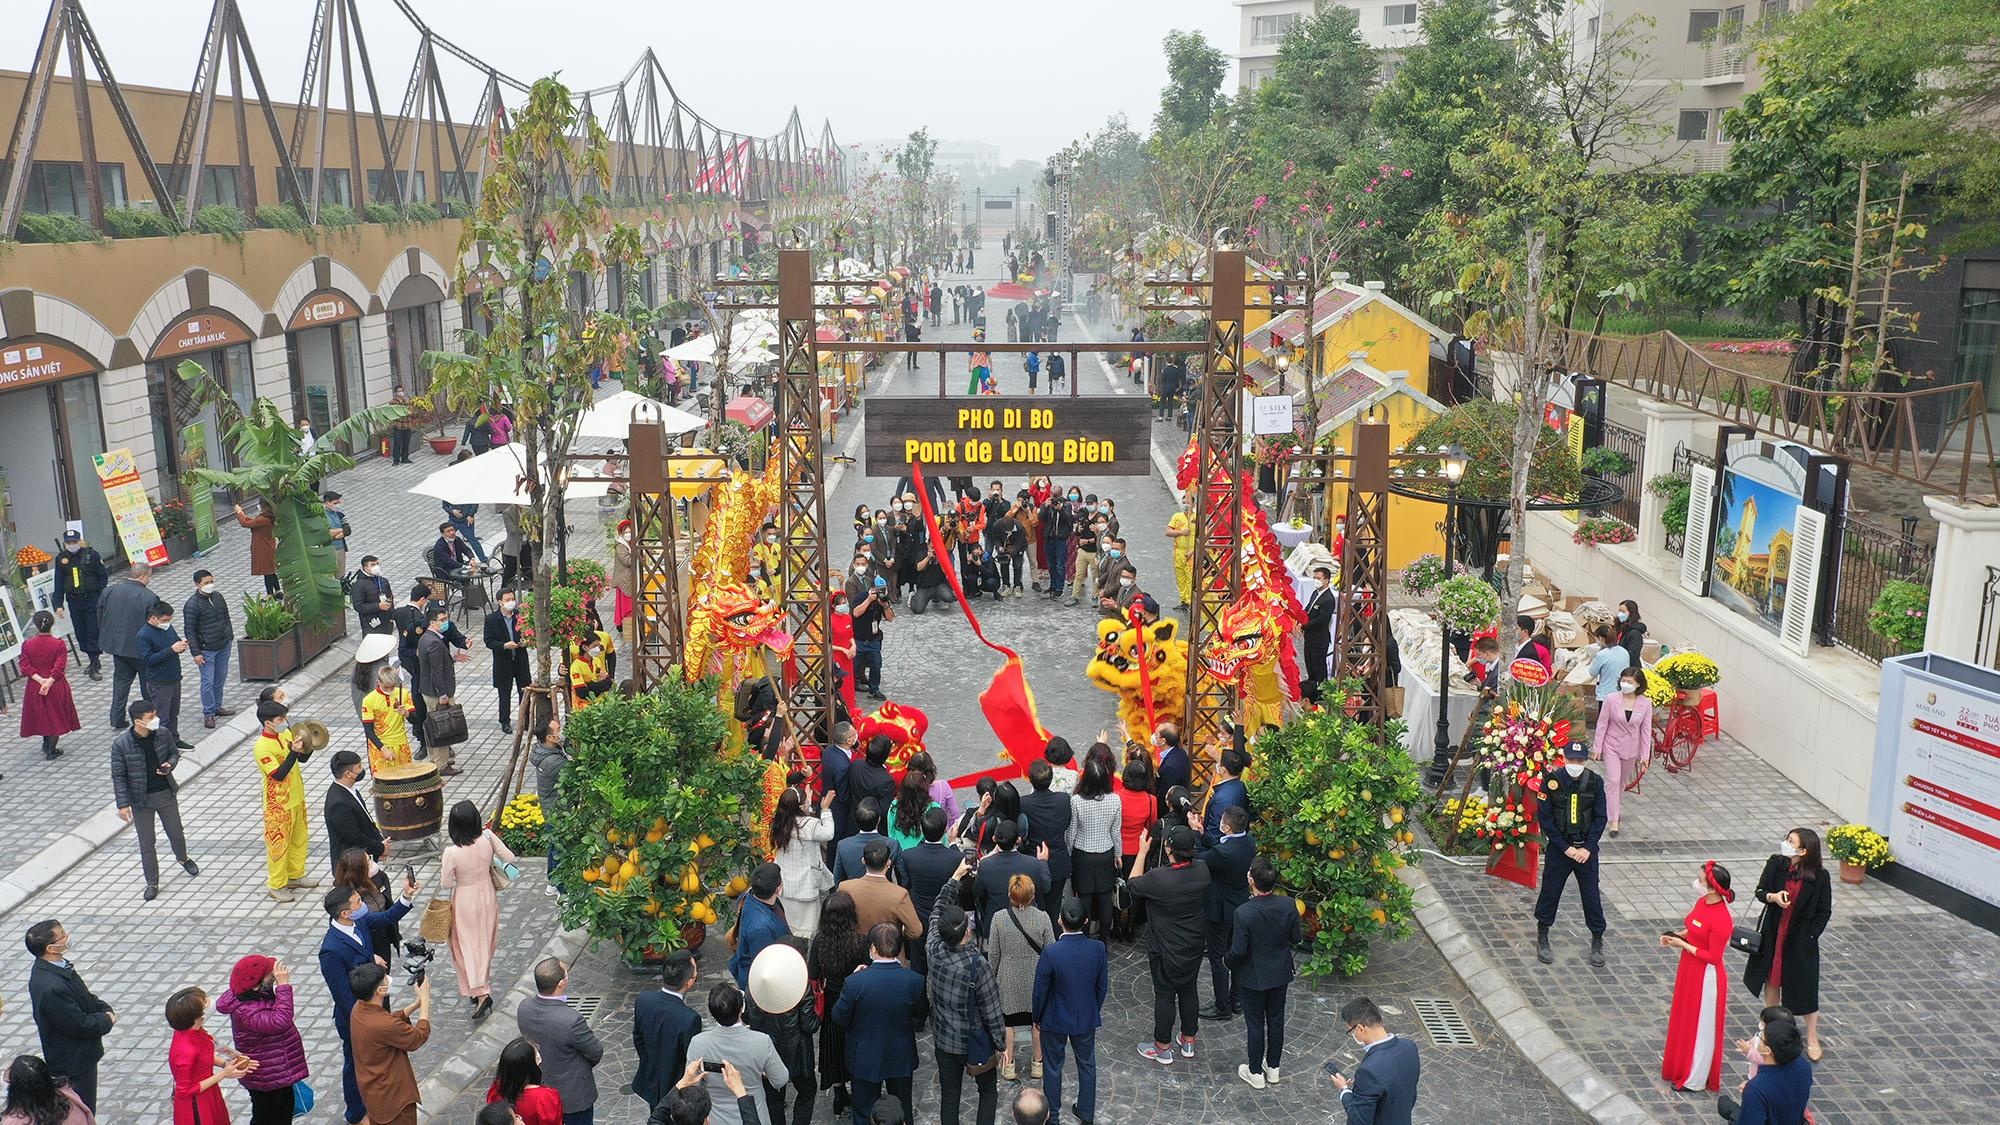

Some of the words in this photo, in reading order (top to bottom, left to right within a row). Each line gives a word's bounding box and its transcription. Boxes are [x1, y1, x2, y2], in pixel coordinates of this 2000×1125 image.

[178, 338, 194, 348] CHAY
[206, 334, 215, 342] AN
[215, 332, 226, 343] LẠC
[40, 361, 61, 376] VIỆT
[958, 408, 994, 429] PHO
[1003, 408, 1021, 429] DI
[1030, 408, 1053, 429] BO
[905, 439, 956, 463] Pont
[965, 439, 992, 463] de
[1001, 438, 1055, 465] Long
[1063, 437, 1114, 463] Bien
